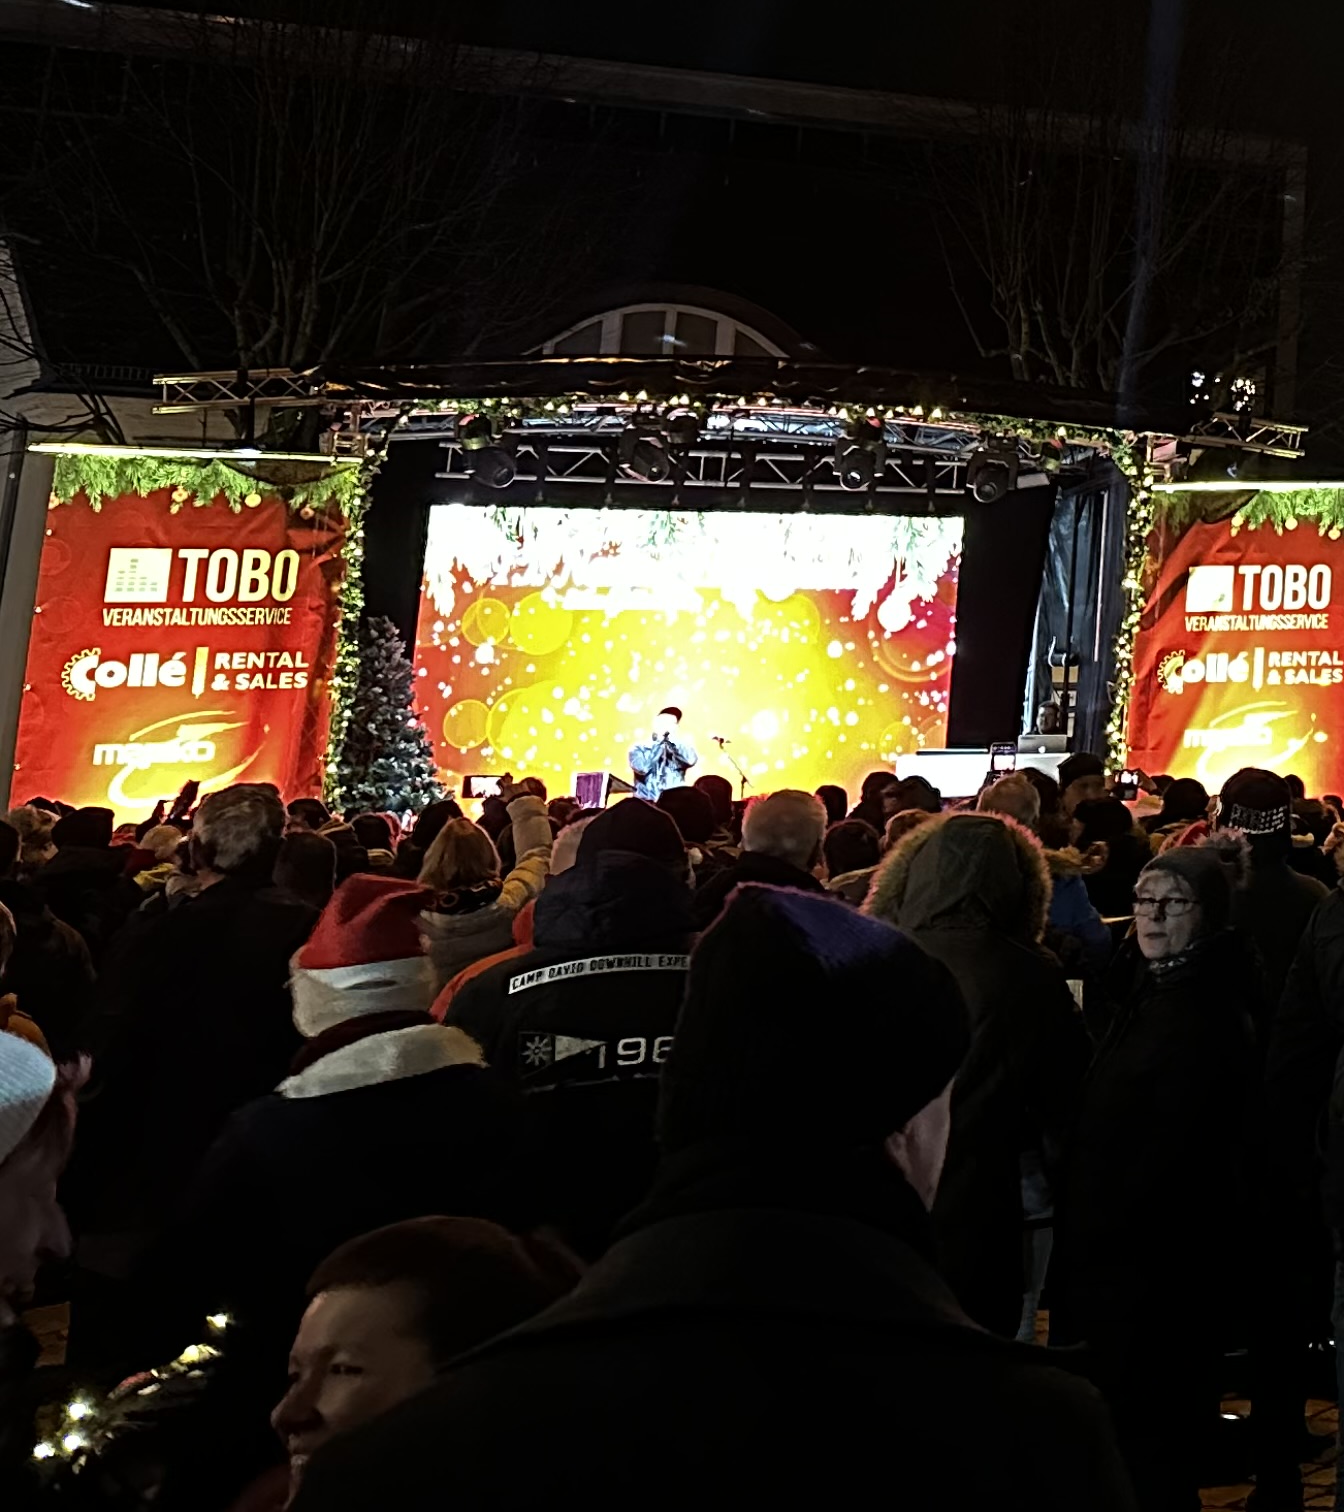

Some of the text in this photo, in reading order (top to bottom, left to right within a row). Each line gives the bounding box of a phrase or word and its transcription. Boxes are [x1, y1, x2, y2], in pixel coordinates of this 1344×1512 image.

[178, 548, 300, 603] TOBO
[1238, 564, 1332, 611] TOBO
[102, 607, 293, 627] VERANSTALTUNGSSERVICE
[1185, 613, 1329, 632] VERANSTALTUNGSSERVICE
[214, 651, 309, 669] RENTAL
[1268, 650, 1344, 668] RENTAL
[61, 648, 187, 701] Collé
[211, 672, 309, 691] & SALES
[1157, 649, 1250, 694] Collé
[1266, 669, 1343, 685] & SALES
[512, 972, 543, 990] CAMP
[548, 962, 584, 979] DAVID
[590, 955, 652, 971] DOWNHILL
